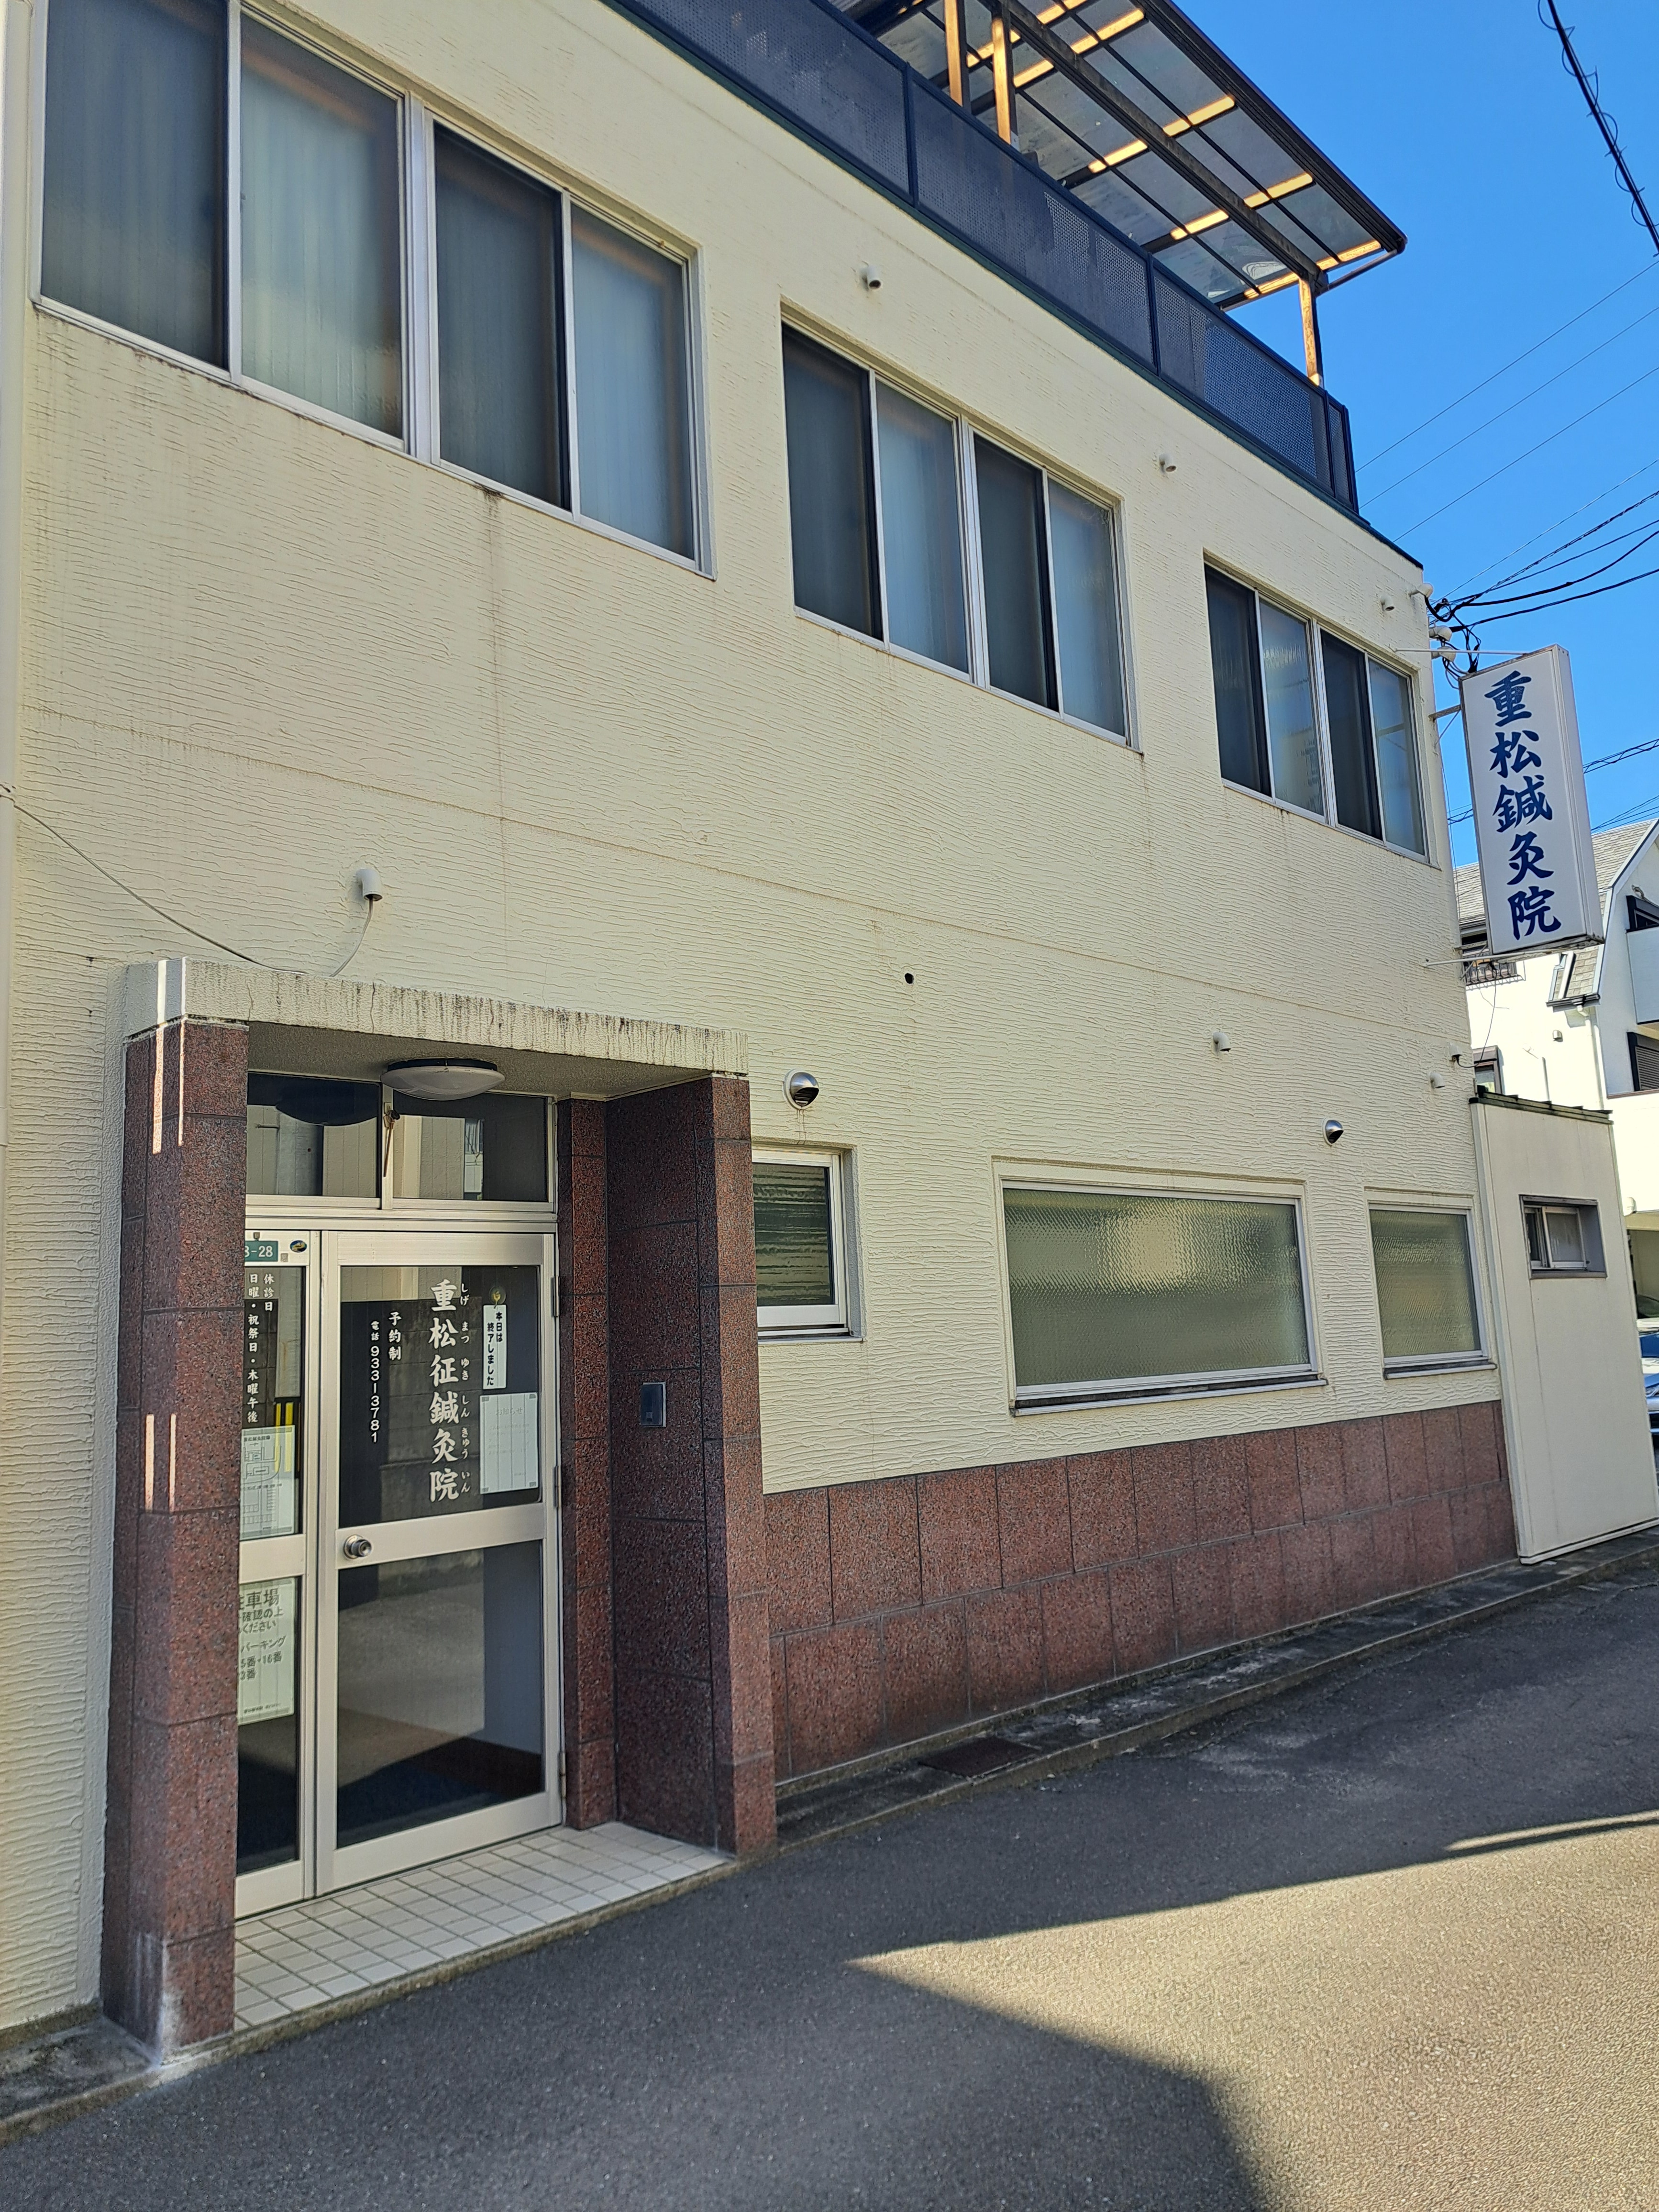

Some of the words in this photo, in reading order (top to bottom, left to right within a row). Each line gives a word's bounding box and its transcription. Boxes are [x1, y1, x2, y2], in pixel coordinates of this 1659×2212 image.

[1484, 670, 1561, 940] 重松鍼灸院
[263, 1273, 275, 1312] 休診日
[247, 1273, 260, 1424] 日曜・祝祭日・木曜午後
[370, 1320, 379, 1341] 電話
[388, 1311, 402, 1360] 予約制
[487, 1322, 495, 1386] 終了しました
[428, 1278, 459, 1503] 重松征鍼灸院
[239, 1620, 276, 1634] ください
